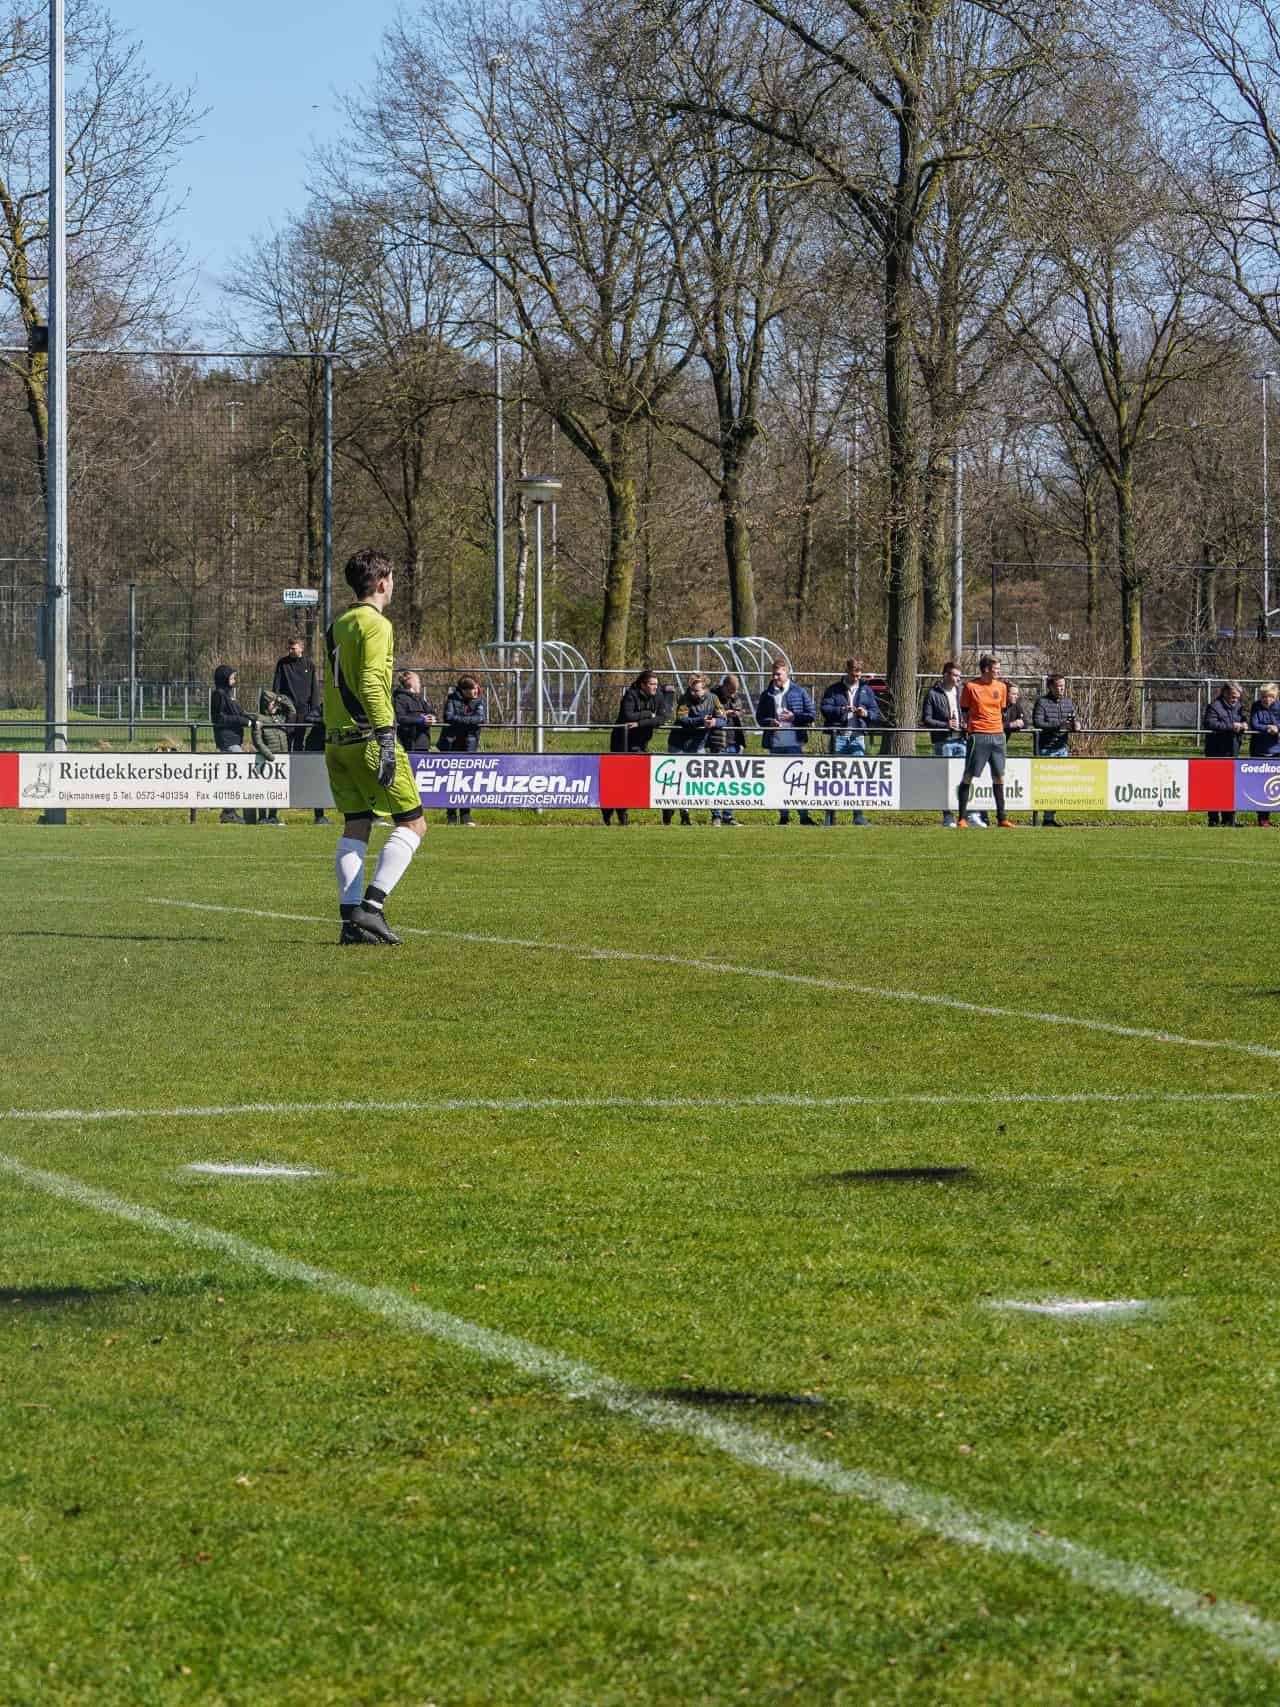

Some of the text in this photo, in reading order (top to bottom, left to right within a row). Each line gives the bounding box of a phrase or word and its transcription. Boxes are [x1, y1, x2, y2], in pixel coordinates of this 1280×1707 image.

[59, 761, 288, 783] Rietdekkersbedrijf B. KOK
[417, 758, 500, 769] AUTOBEDRIJF
[685, 759, 766, 779] GRAVE
[814, 760, 893, 780] GRAVE
[415, 770, 592, 793] ErikHuzen.nl
[685, 781, 766, 797] INCASSO
[814, 780, 893, 797] HOLTEN
[956, 779, 1024, 801] annk
[120, 791, 133, 800] Tel.
[196, 791, 209, 800] Fax
[242, 791, 264, 801] Laren
[449, 794, 589, 806] UW MOBILITEITSCENTRUM
[1114, 780, 1181, 807] Wansink
